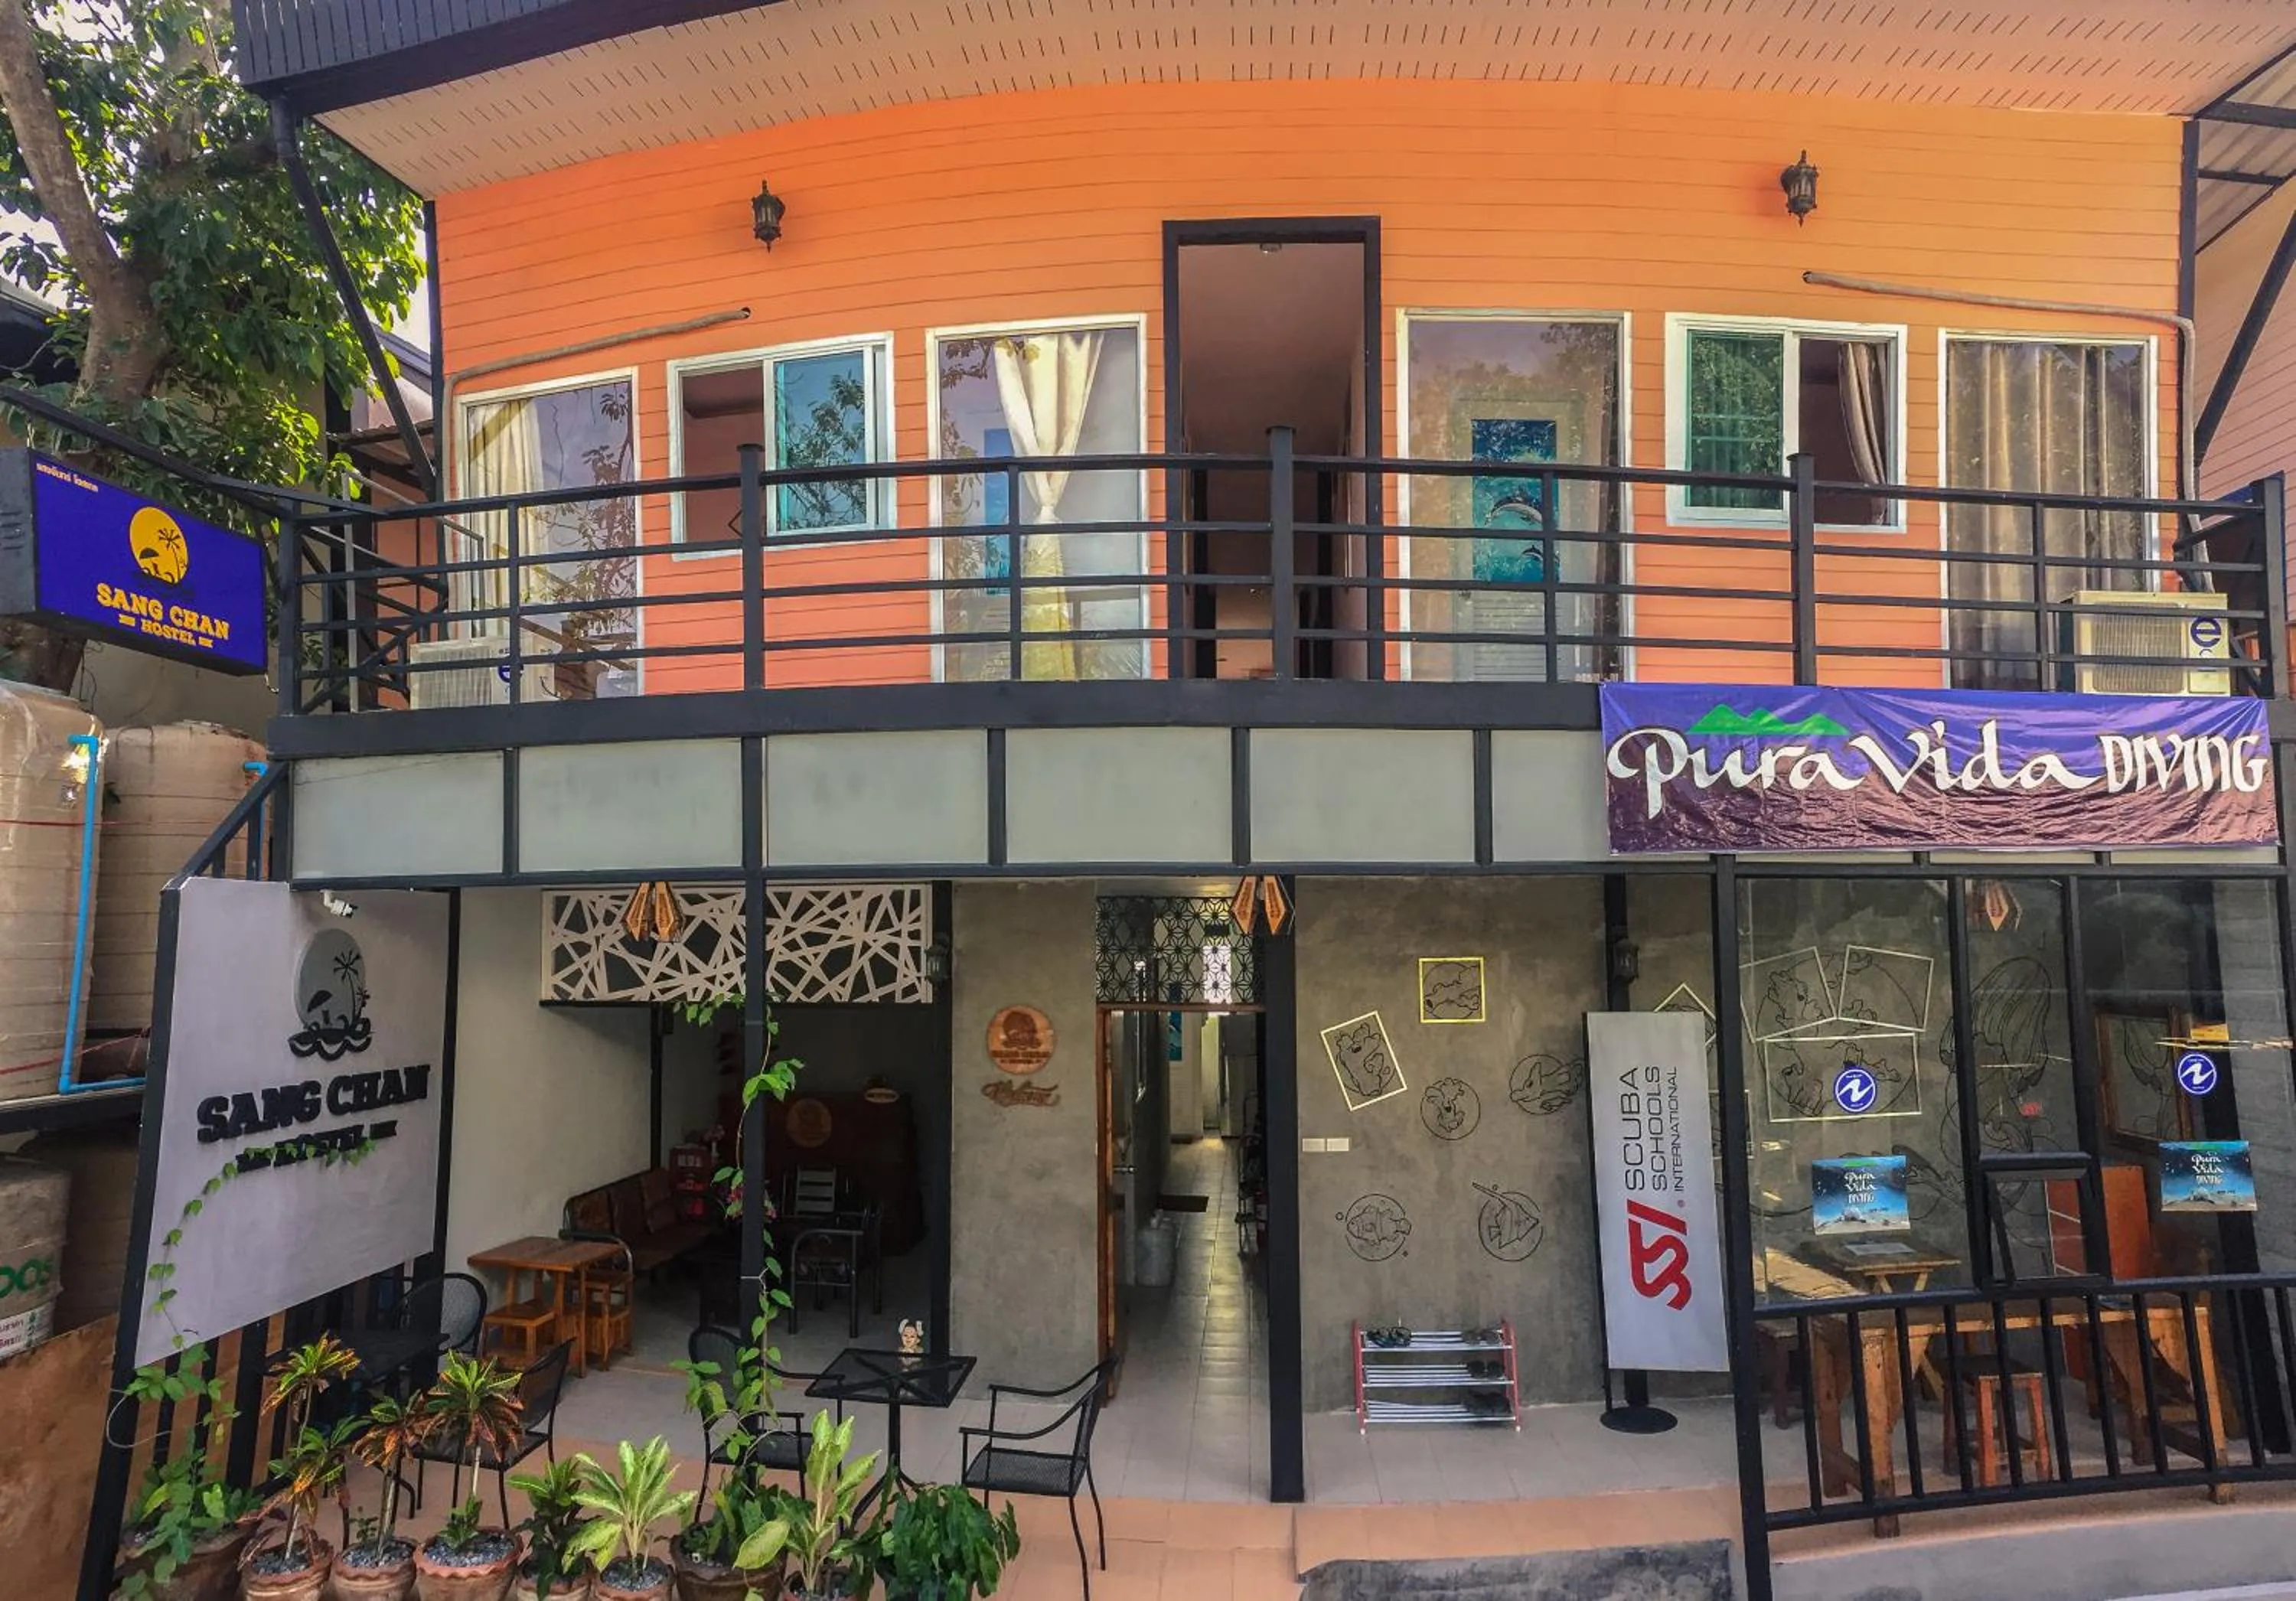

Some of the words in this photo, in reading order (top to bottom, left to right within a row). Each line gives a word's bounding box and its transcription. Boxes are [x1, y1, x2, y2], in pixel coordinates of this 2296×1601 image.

[96, 582, 163, 621] SANG
[169, 605, 229, 640] CHAN
[141, 618, 197, 646] HOSTEL
[1606, 728, 1867, 820] Pura
[1848, 719, 2109, 794] Vida
[2100, 732, 2267, 793] DIVING
[197, 1080, 322, 1143] SANG
[326, 1065, 431, 1117] CHAN
[1619, 1068, 1645, 1191] SCUBA
[1645, 1066, 1668, 1192] SCHOOLS
[1666, 1067, 1684, 1192] INTERNATIONAL
